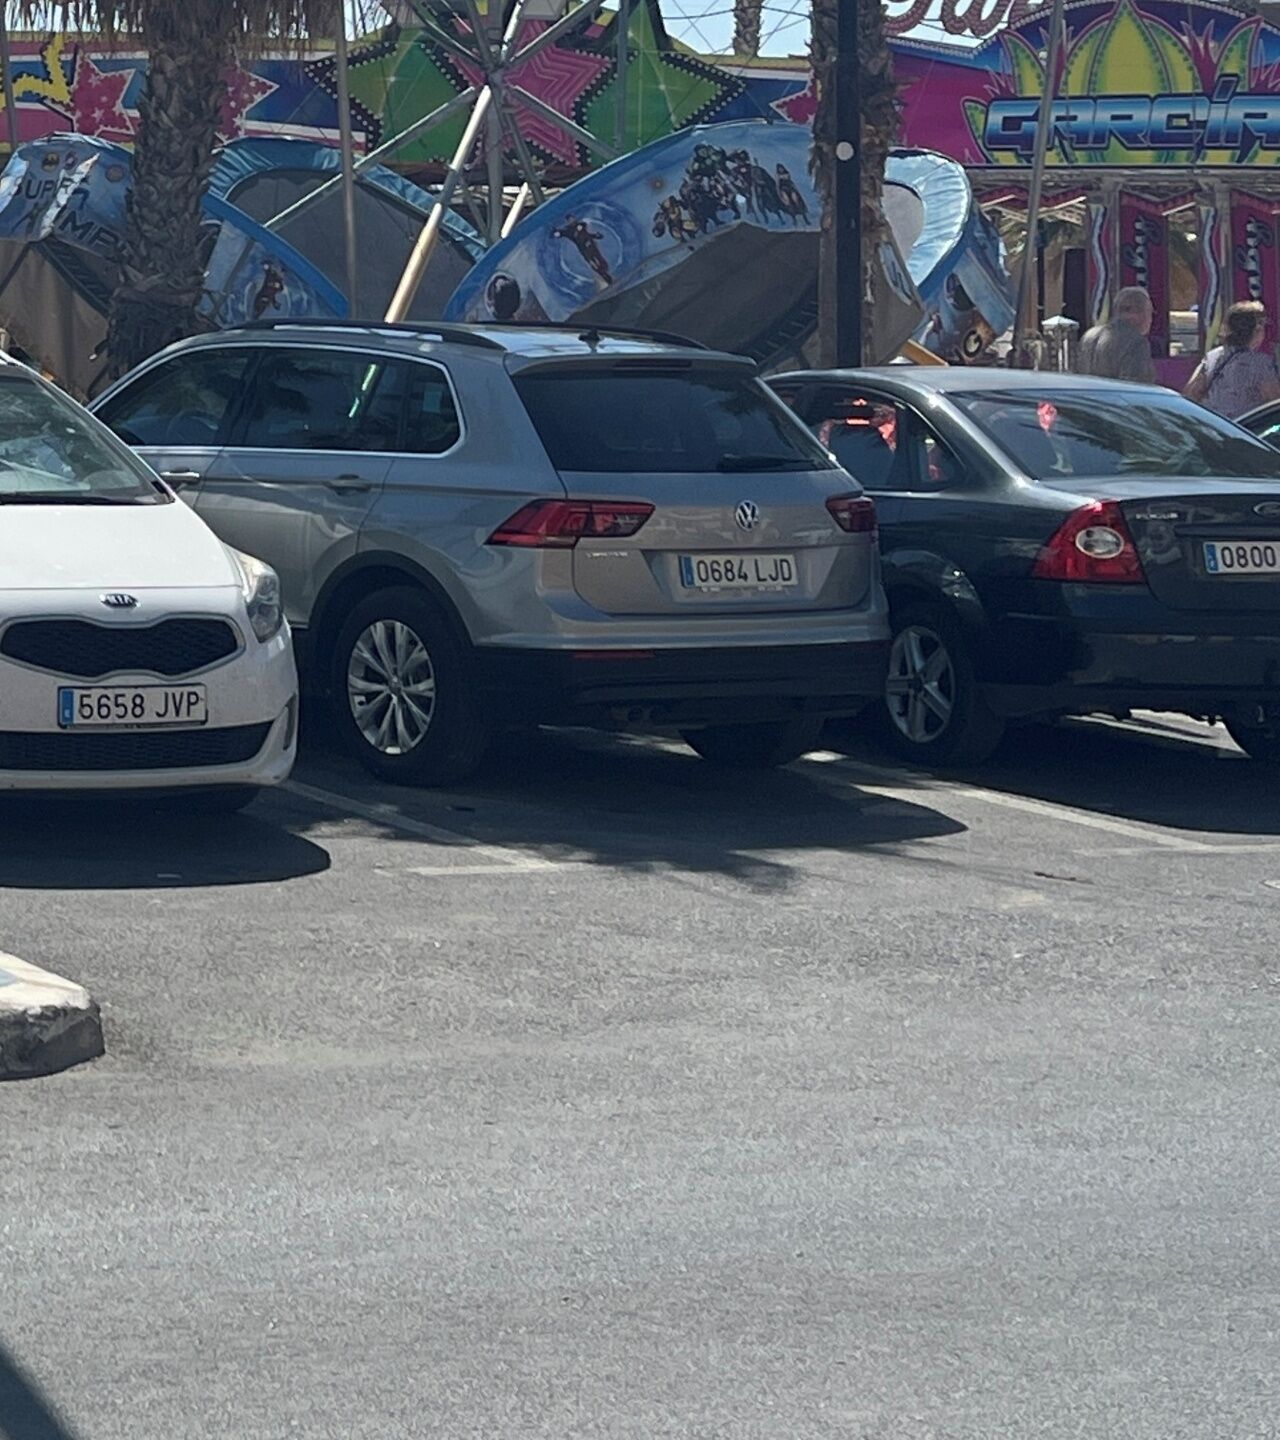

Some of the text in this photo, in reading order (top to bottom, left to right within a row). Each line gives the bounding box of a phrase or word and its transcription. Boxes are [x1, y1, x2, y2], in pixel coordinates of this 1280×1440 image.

[1220, 546, 1276, 568] 0800
[697, 558, 792, 582] 0684 LJD
[78, 691, 200, 719] 5658 JVP
